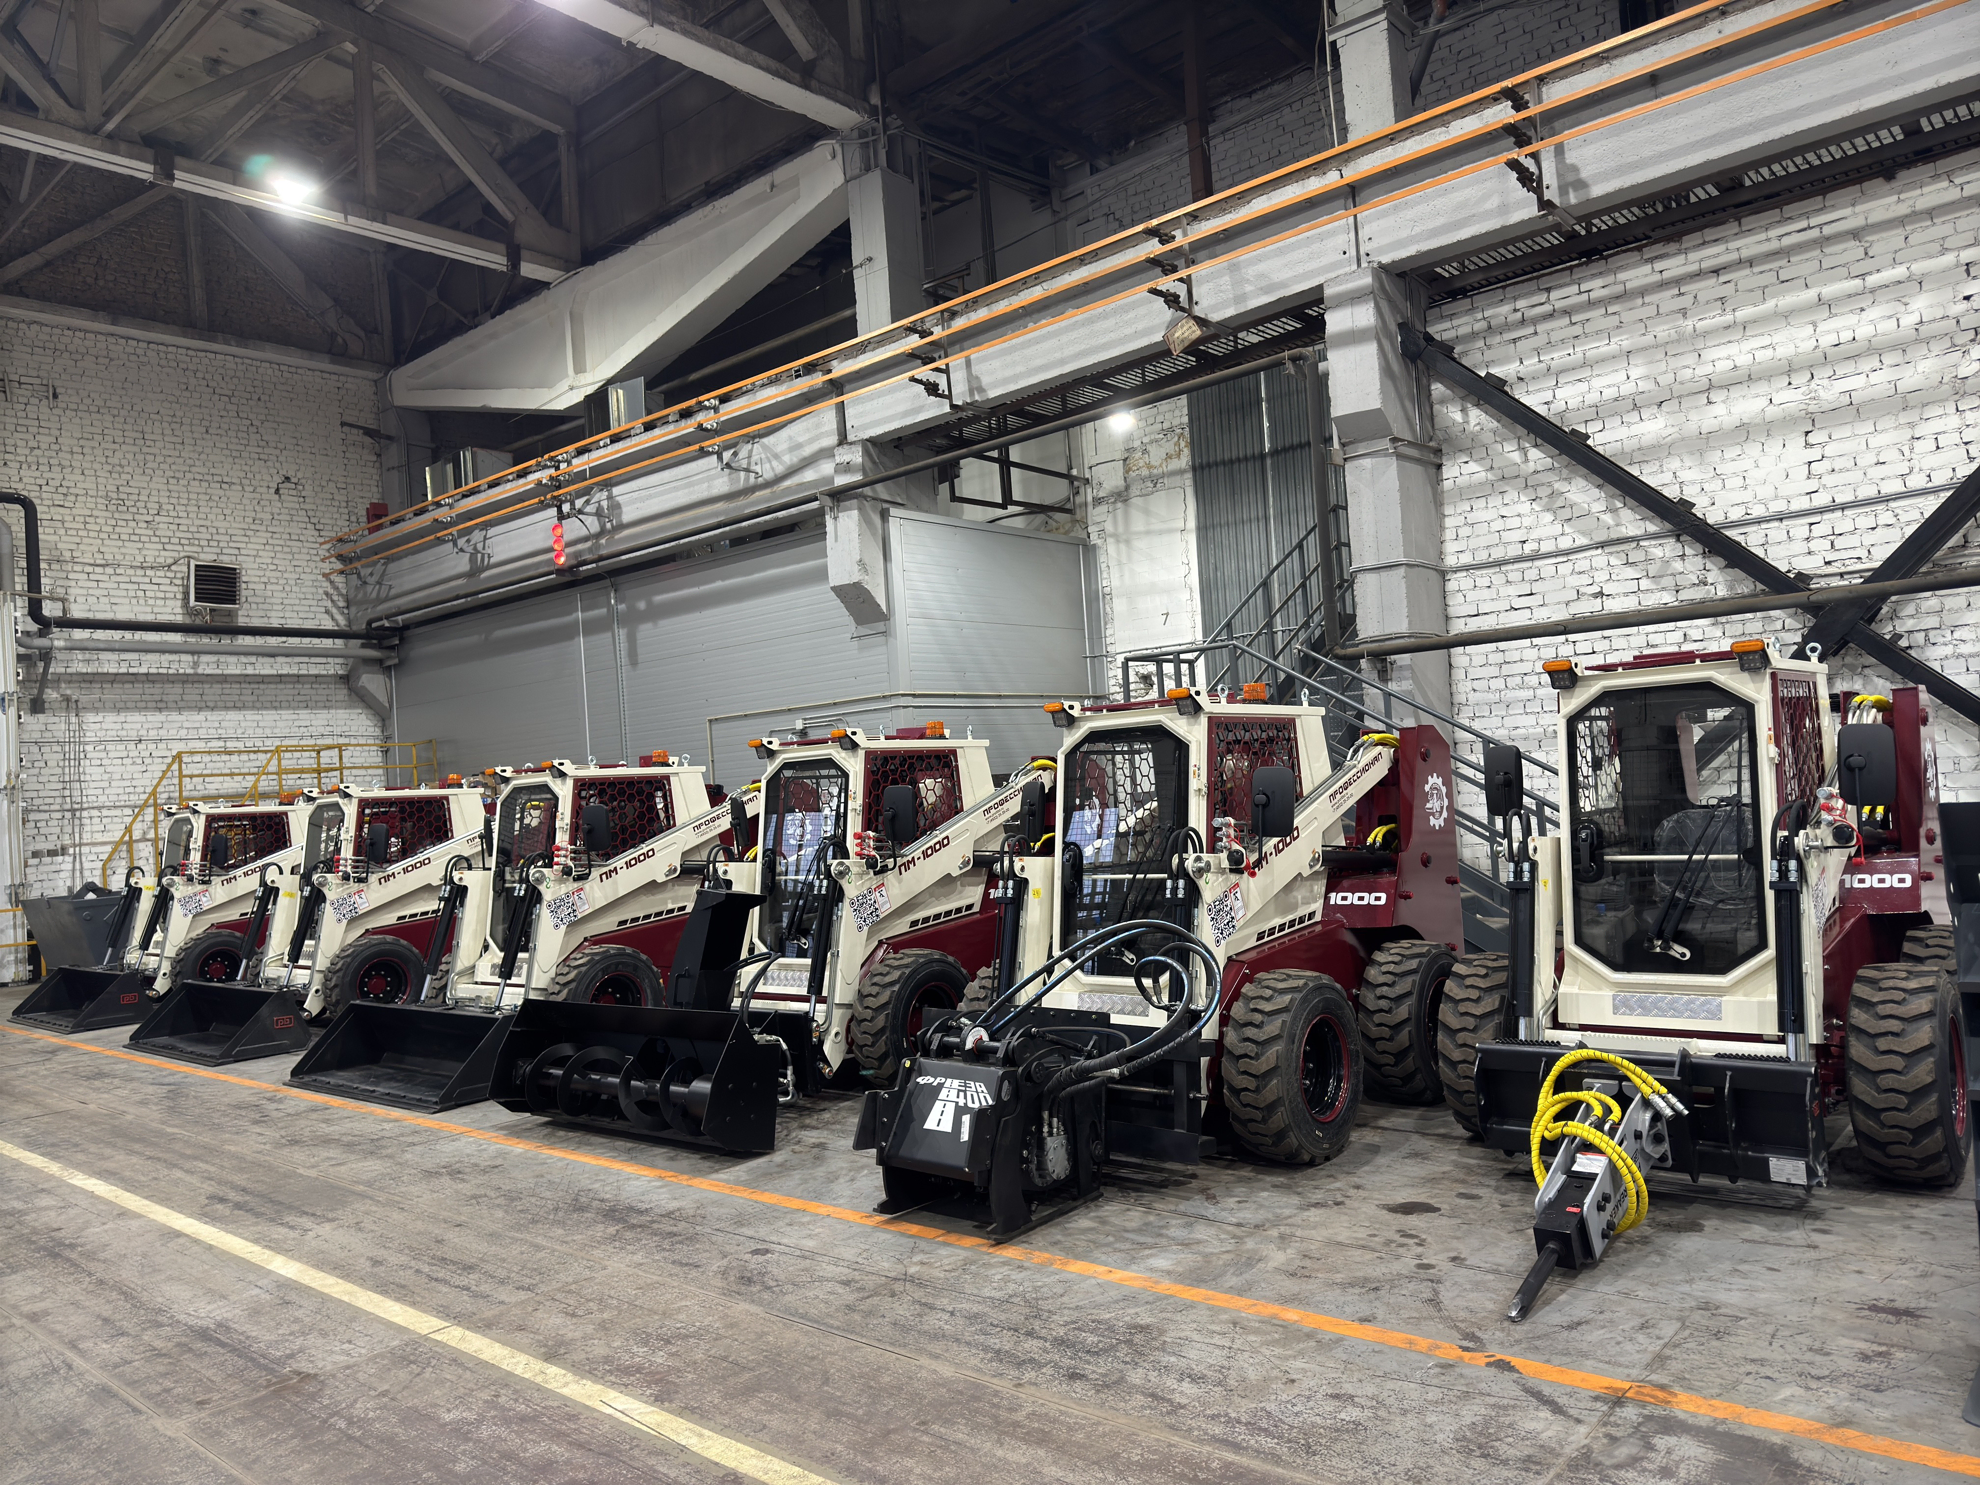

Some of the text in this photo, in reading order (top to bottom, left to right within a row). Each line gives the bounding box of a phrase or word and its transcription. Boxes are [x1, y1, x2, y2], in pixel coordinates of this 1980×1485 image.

[1328, 751, 1383, 803] ПРОФЕССИОНАЛ
[982, 774, 1043, 817] ПРОФЕССИАЛ
[692, 794, 758, 832] ПРОФЕССНАЛ
[377, 856, 431, 886] ПМ-1000
[598, 847, 656, 883] ПМ-1000
[897, 835, 950, 876] ПМ-1000
[220, 864, 266, 887] ПМ-100
[1840, 873, 1912, 888] 1000
[1327, 892, 1387, 905] 1000
[915, 1075, 989, 1094] ФРЕЗА
